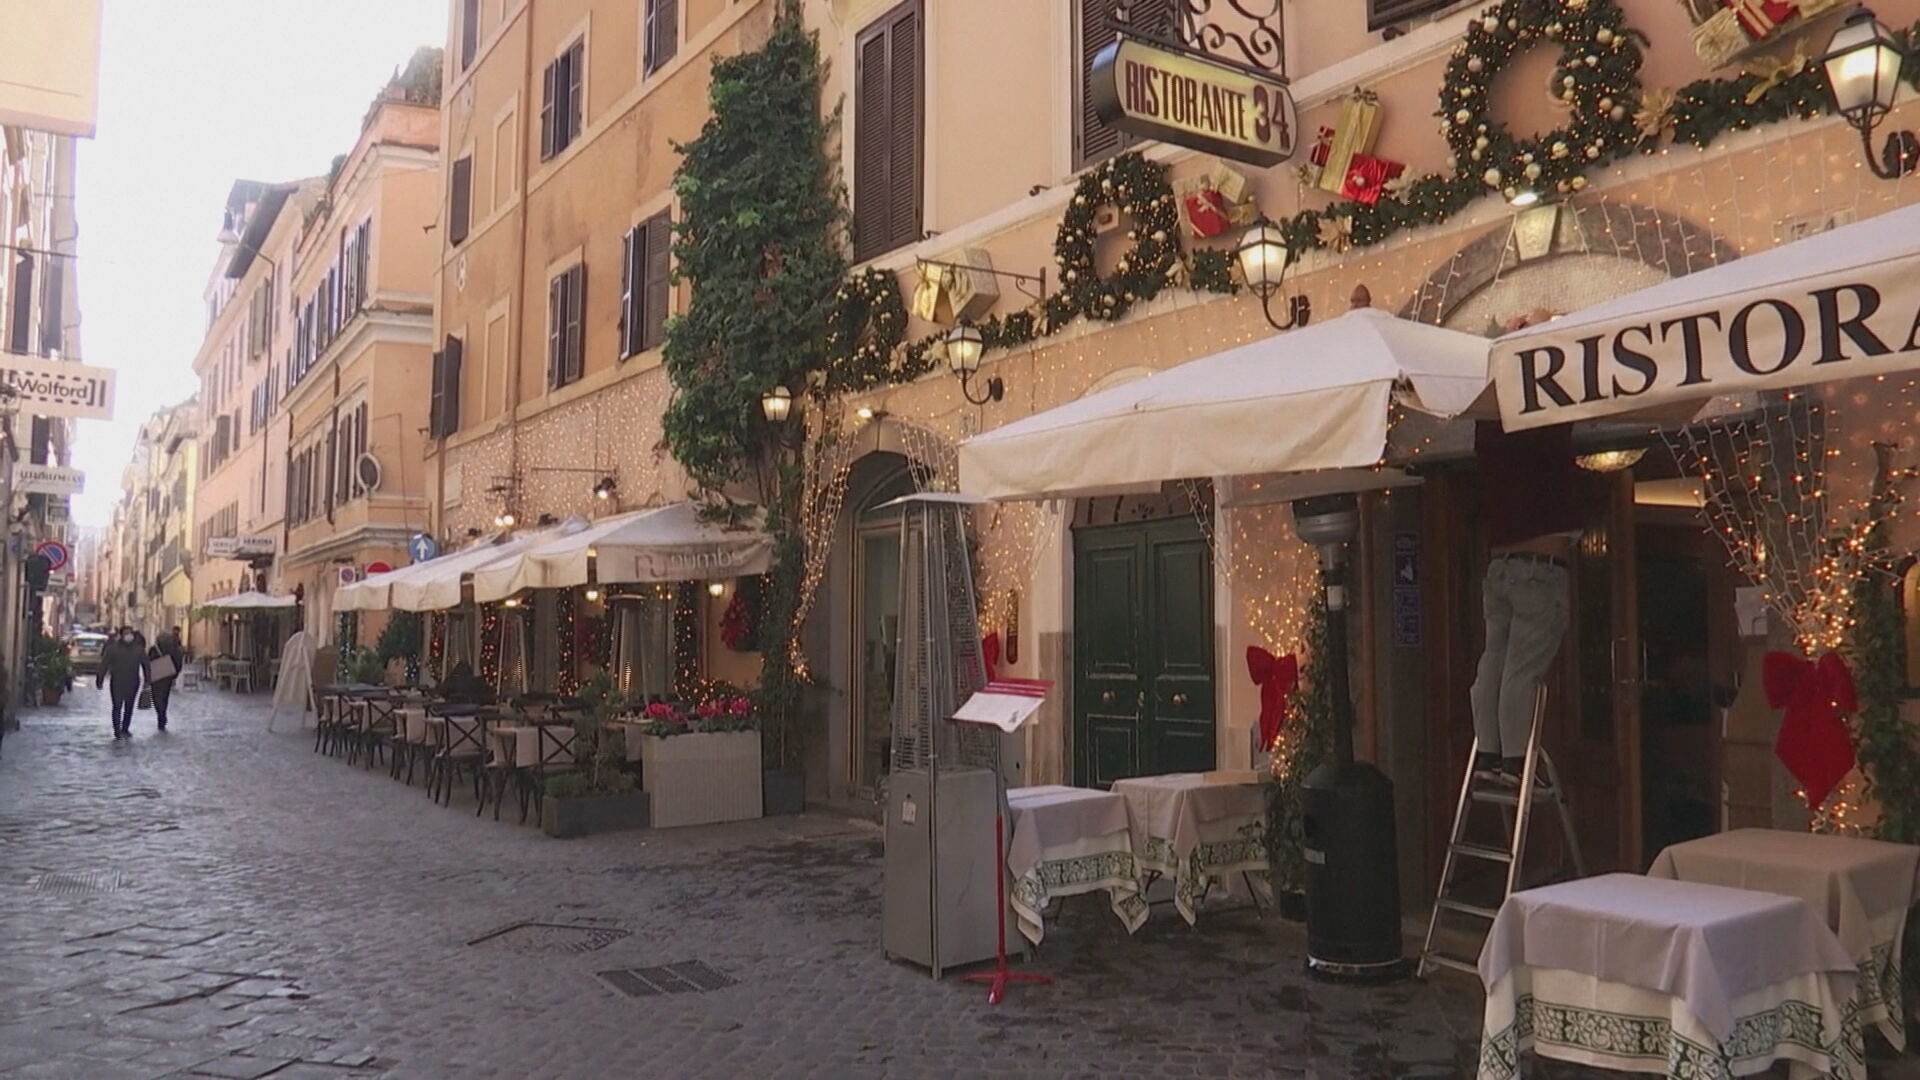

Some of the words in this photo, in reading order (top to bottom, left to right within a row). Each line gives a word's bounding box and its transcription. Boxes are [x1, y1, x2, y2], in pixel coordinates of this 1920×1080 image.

[1126, 60, 1248, 140] RISTORANTE
[1253, 84, 1290, 150] 34
[17, 377, 88, 399] Wolford
[1514, 282, 1920, 415] RISTOR
